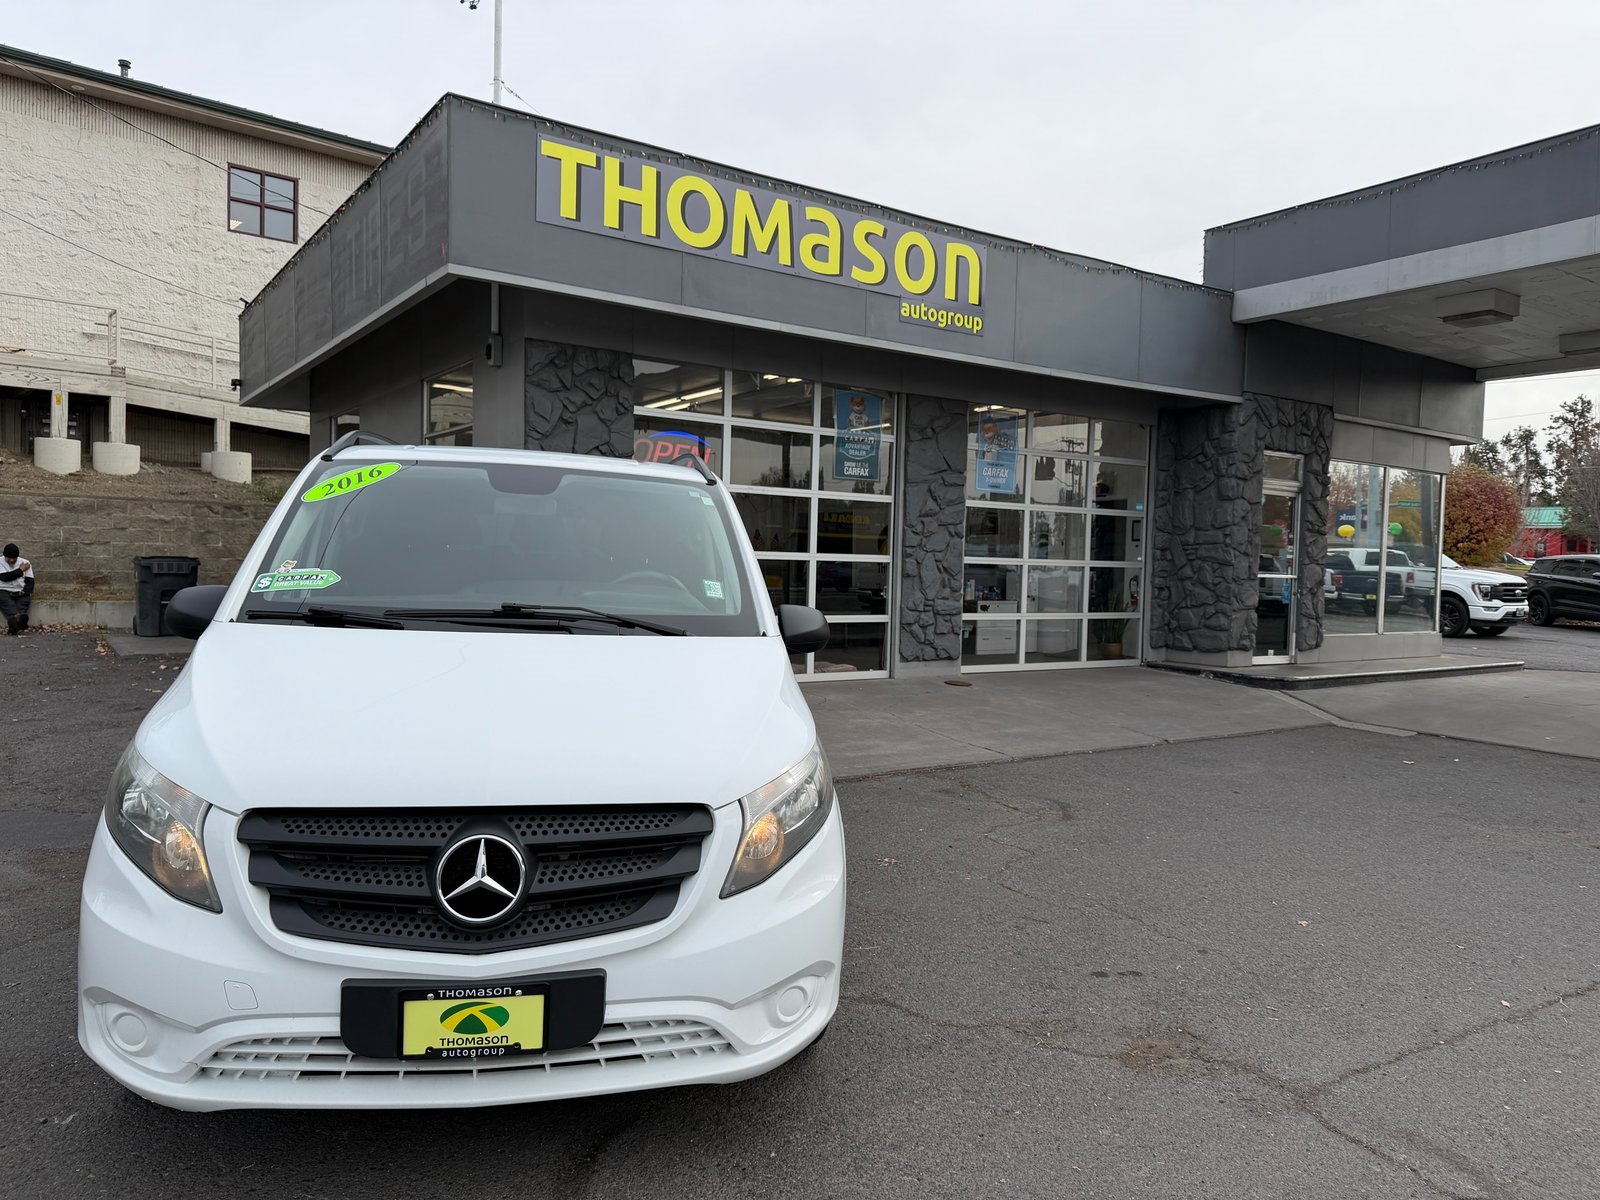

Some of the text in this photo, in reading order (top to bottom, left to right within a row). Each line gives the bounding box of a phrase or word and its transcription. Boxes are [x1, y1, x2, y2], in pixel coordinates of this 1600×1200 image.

[900, 299, 984, 335] autogroup
[845, 443, 871, 451] ADVANTAGE
[634, 439, 711, 468] OPEN
[844, 467, 869, 476] CARFAX
[983, 467, 1009, 477] CARFAX
[322, 466, 382, 496] 2016
[442, 1048, 504, 1057] autogroup
